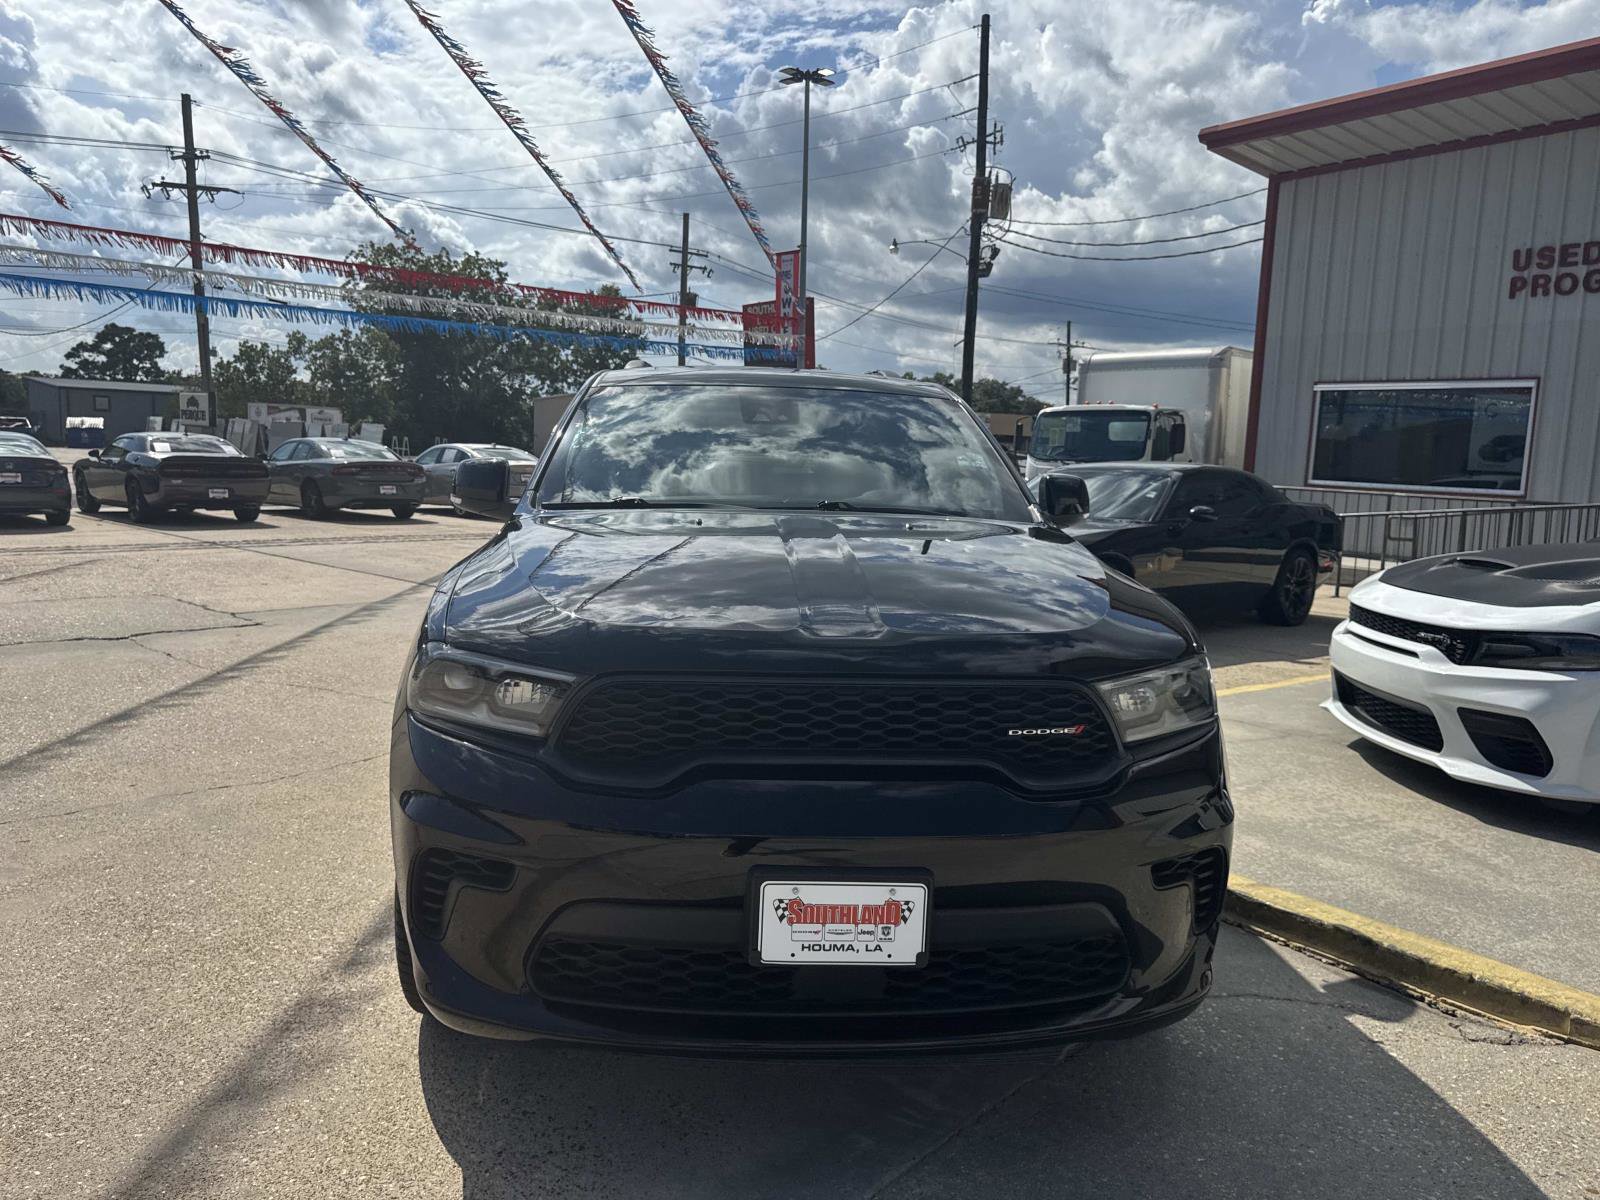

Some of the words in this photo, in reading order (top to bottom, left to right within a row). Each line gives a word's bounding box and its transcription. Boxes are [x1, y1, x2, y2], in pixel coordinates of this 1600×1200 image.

[1513, 241, 1600, 272] USED
[1008, 727, 1075, 736] DODGE
[787, 898, 901, 926] SOUTHLAND
[857, 928, 875, 937] Jeep
[801, 943, 859, 954] HOUMA,
[865, 944, 883, 952] LA
